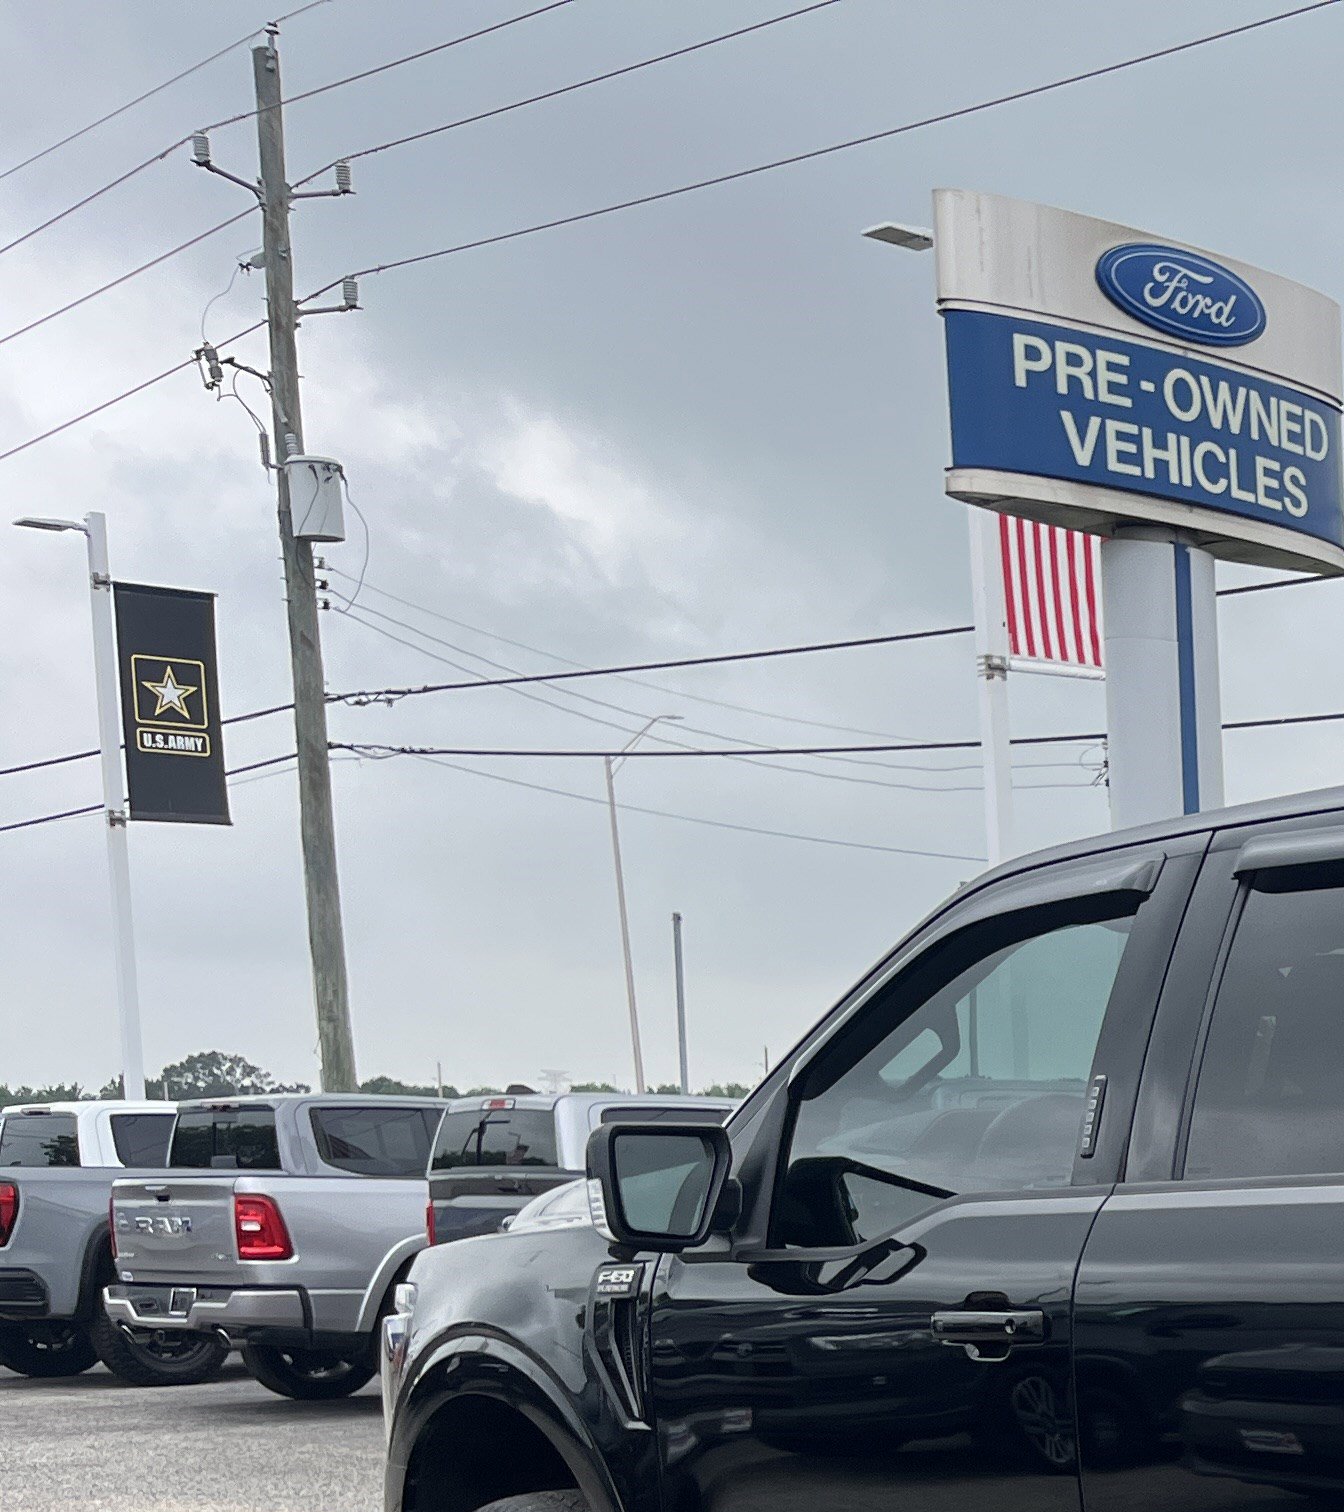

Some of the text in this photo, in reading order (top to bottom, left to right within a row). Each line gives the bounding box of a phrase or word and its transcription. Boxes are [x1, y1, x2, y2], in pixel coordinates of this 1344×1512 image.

[1143, 261, 1237, 328] Ford
[1060, 411, 1309, 518] VEHICLES
[134, 1216, 193, 1235] RAM
